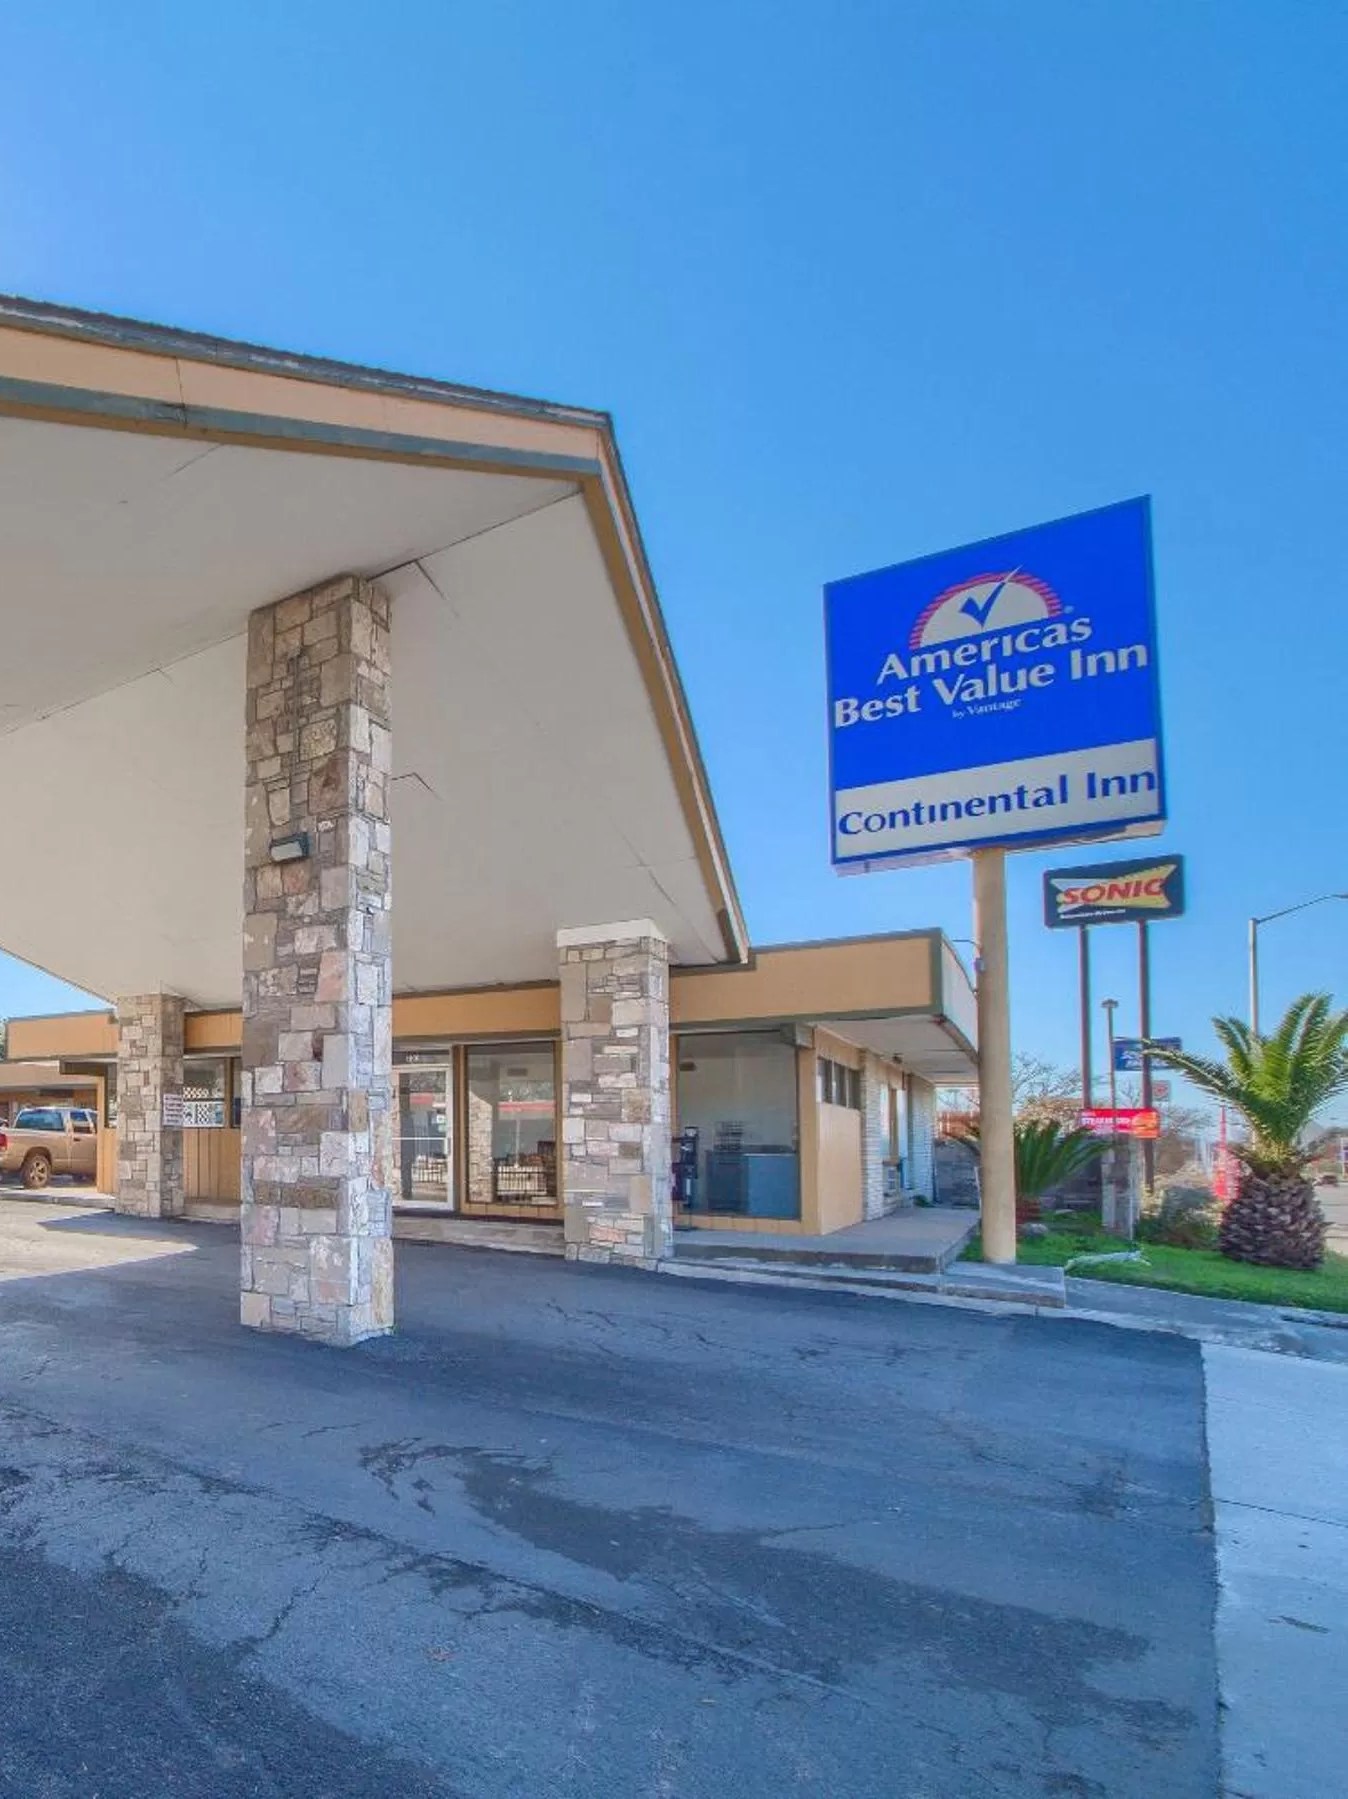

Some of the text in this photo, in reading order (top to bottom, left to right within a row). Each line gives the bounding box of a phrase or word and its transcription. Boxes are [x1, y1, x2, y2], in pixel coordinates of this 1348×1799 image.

[834, 643, 1149, 729] Best Value Inn
[875, 616, 1093, 687] Americas
[838, 769, 1156, 836] Continental Inn
[1062, 877, 1169, 905] SONIC
